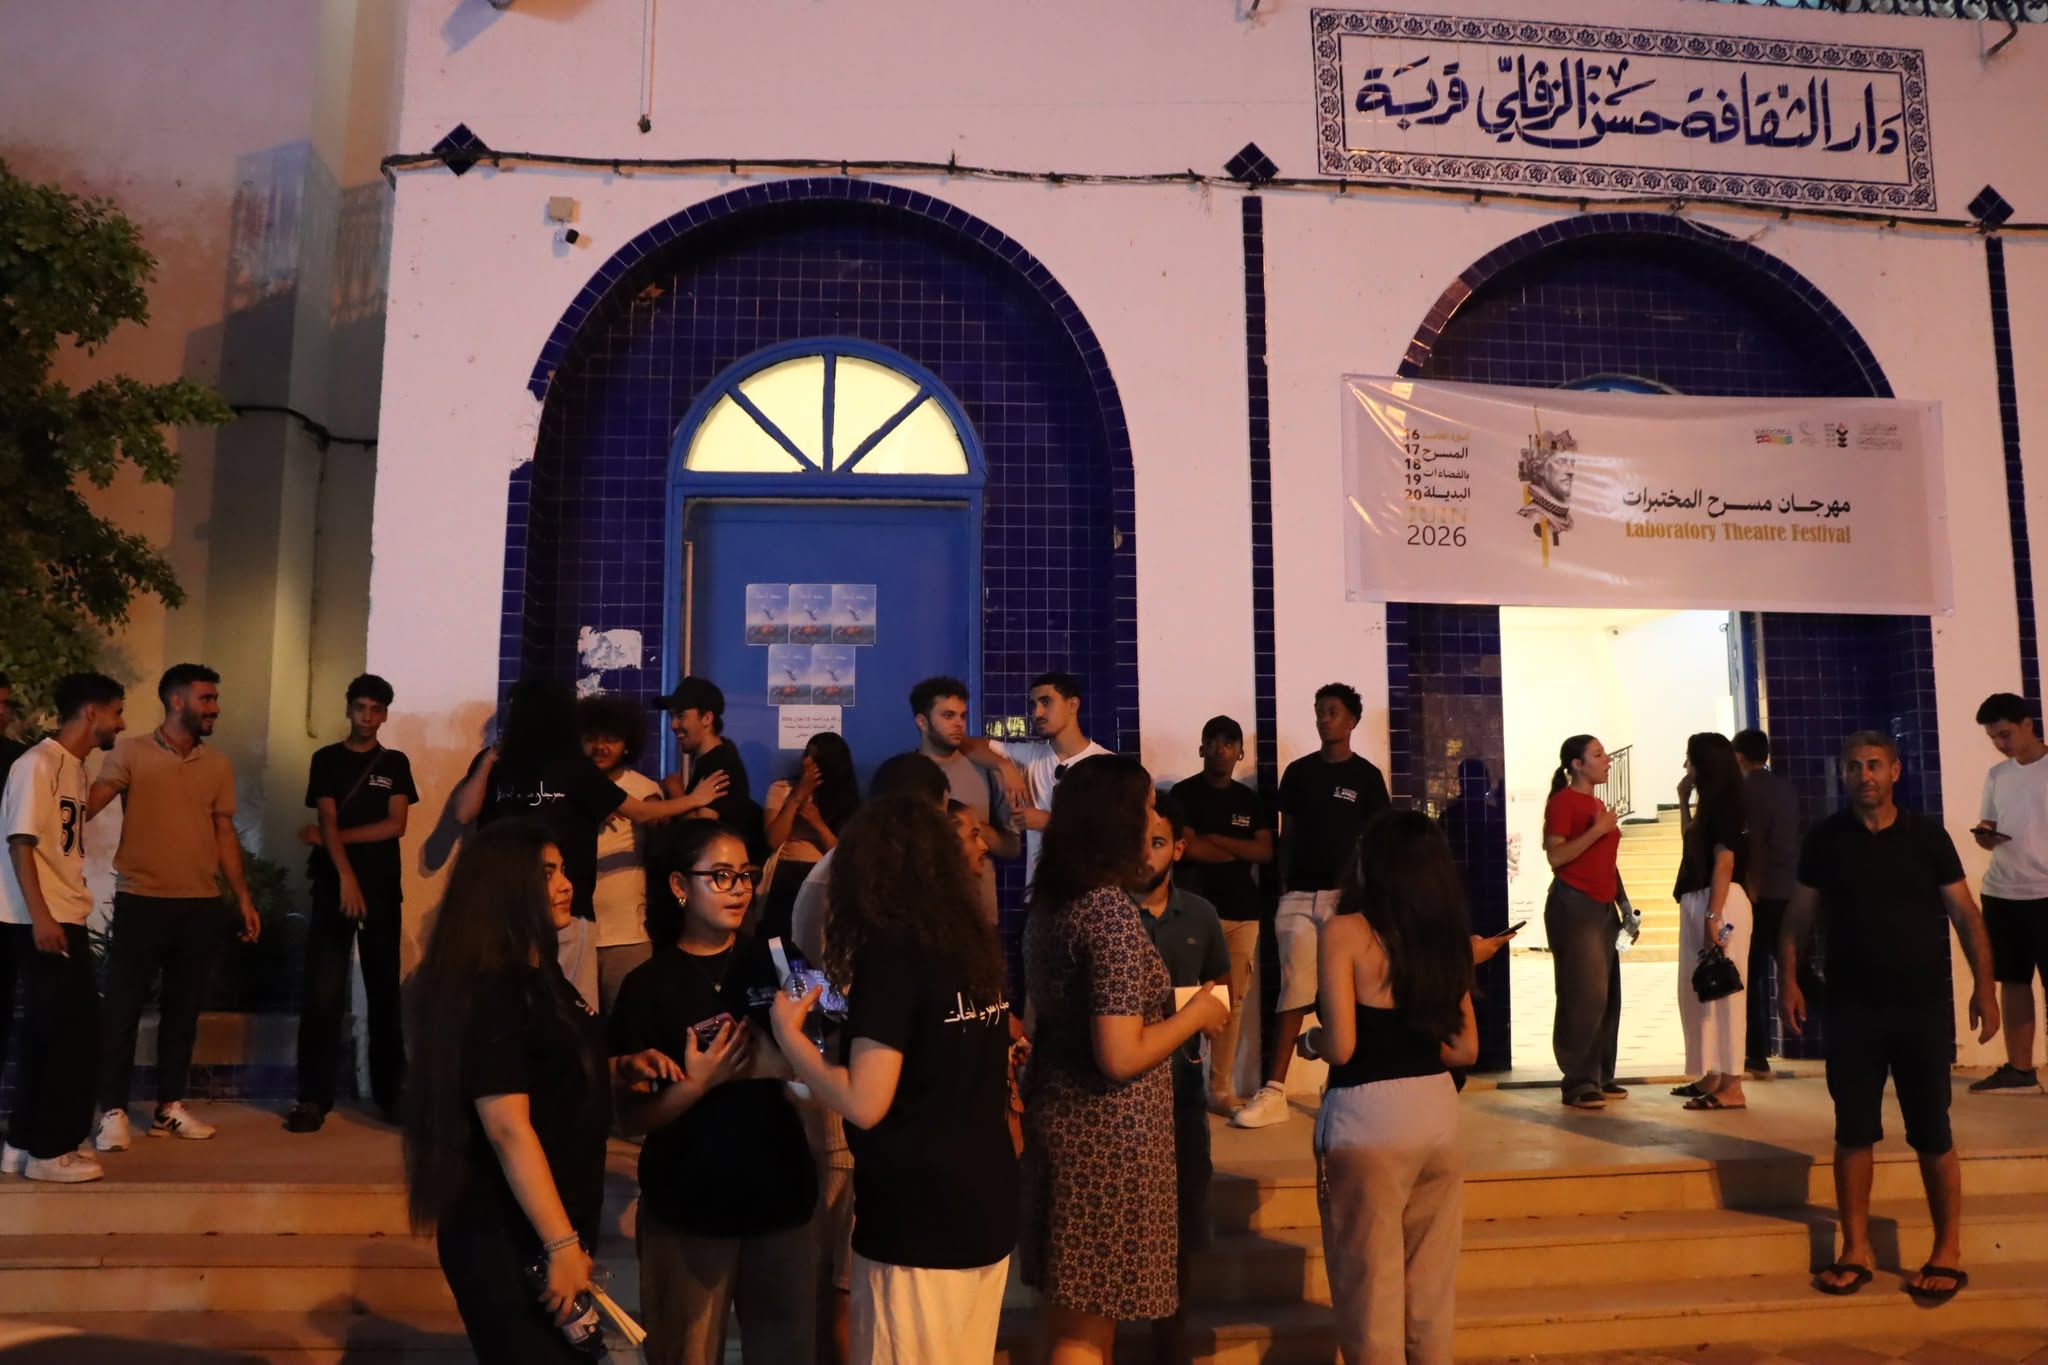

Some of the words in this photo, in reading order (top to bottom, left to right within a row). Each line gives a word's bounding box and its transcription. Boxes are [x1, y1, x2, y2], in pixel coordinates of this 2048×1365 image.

[1404, 429, 1420, 441] 16
[1404, 444, 1420, 455] 17
[1422, 447, 1469, 462] المسرح
[1405, 473, 1421, 485] 19
[1405, 488, 1422, 501] 20
[1423, 486, 1471, 502] البديلة
[1622, 486, 1703, 513] المختبرات
[1706, 494, 1773, 518] مسرح
[1777, 492, 1851, 518] مهرجان
[1406, 524, 1467, 547] 2026
[1625, 519, 1717, 542] Laboratory
[1721, 521, 1787, 541] Theatre
[1791, 523, 1851, 543] Festival
